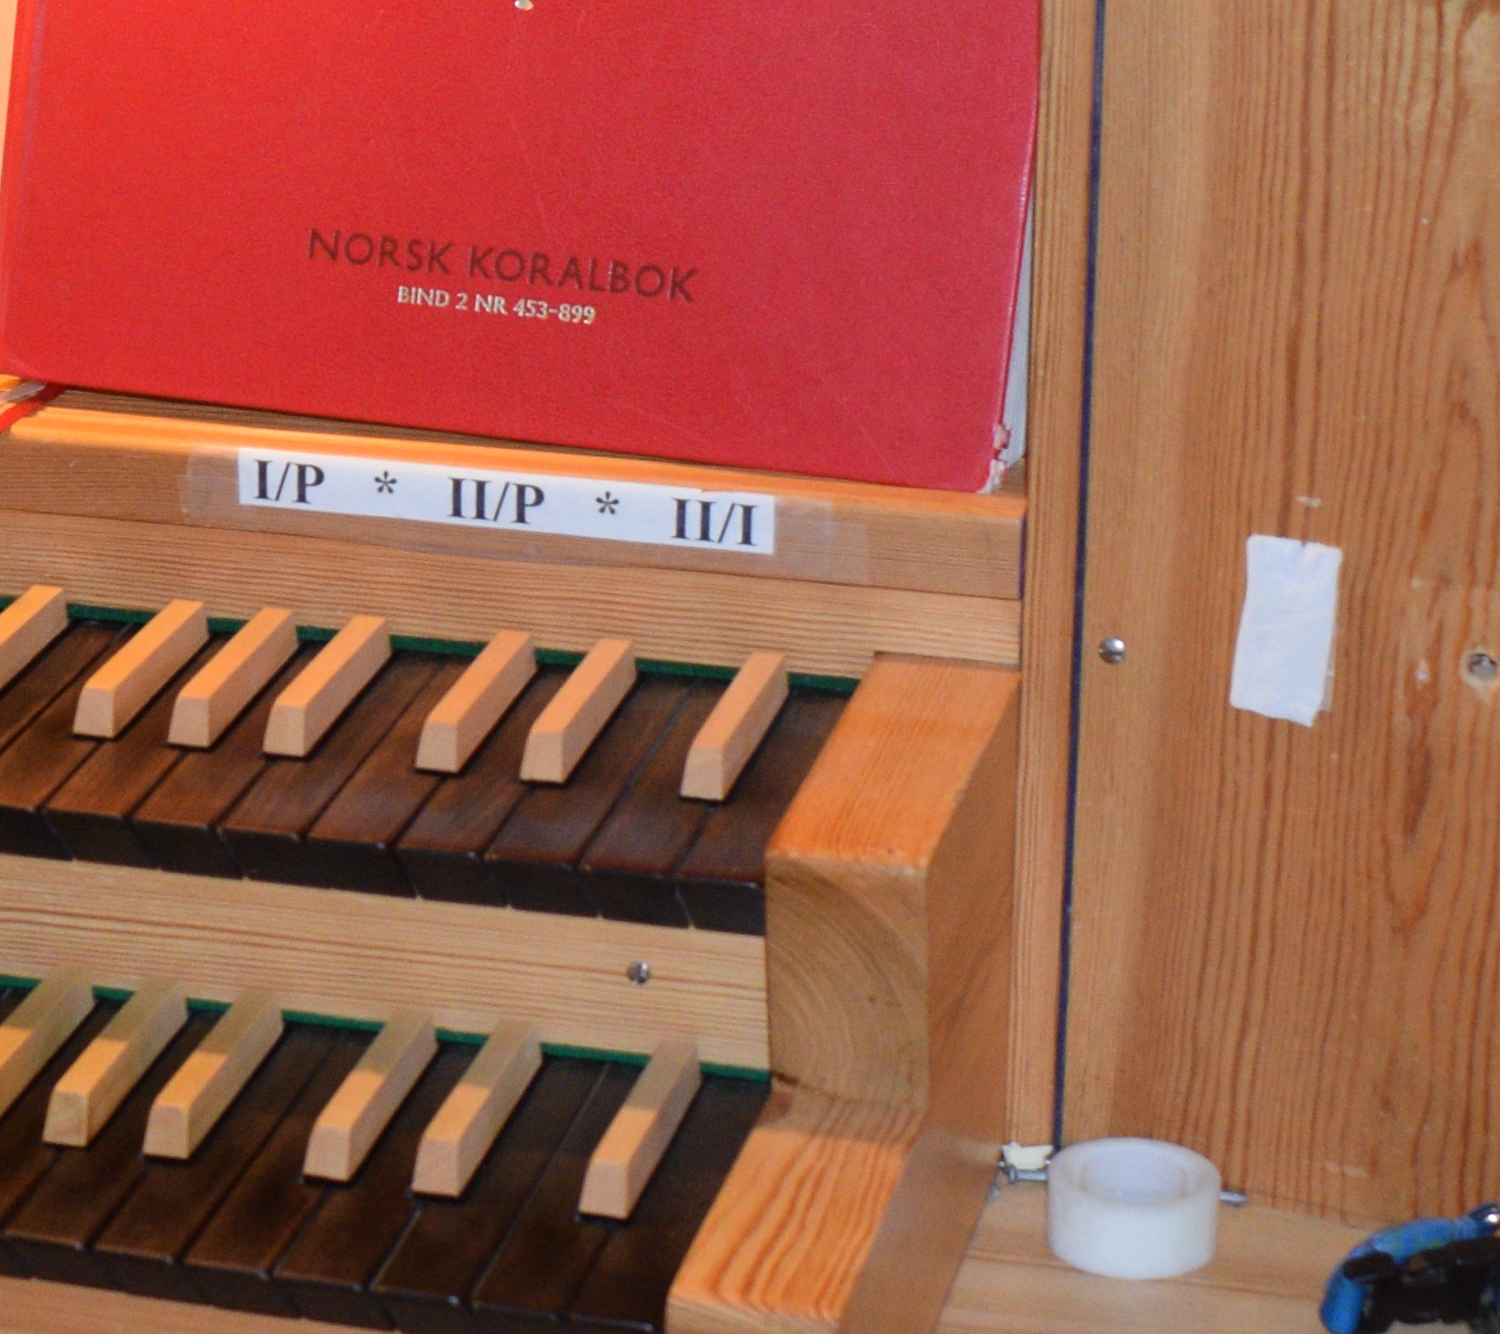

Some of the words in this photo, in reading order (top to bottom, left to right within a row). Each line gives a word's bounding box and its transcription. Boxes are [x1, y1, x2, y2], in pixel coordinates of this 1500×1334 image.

[307, 228, 454, 274] NORSK
[467, 246, 698, 303] KORALBOK
[397, 285, 450, 308] BIND
[455, 292, 467, 311] 2
[474, 295, 508, 316] NR
[513, 299, 597, 325] 453-899
[252, 458, 325, 505] I/P
[448, 477, 545, 525] II/P
[672, 497, 758, 547] II/I
